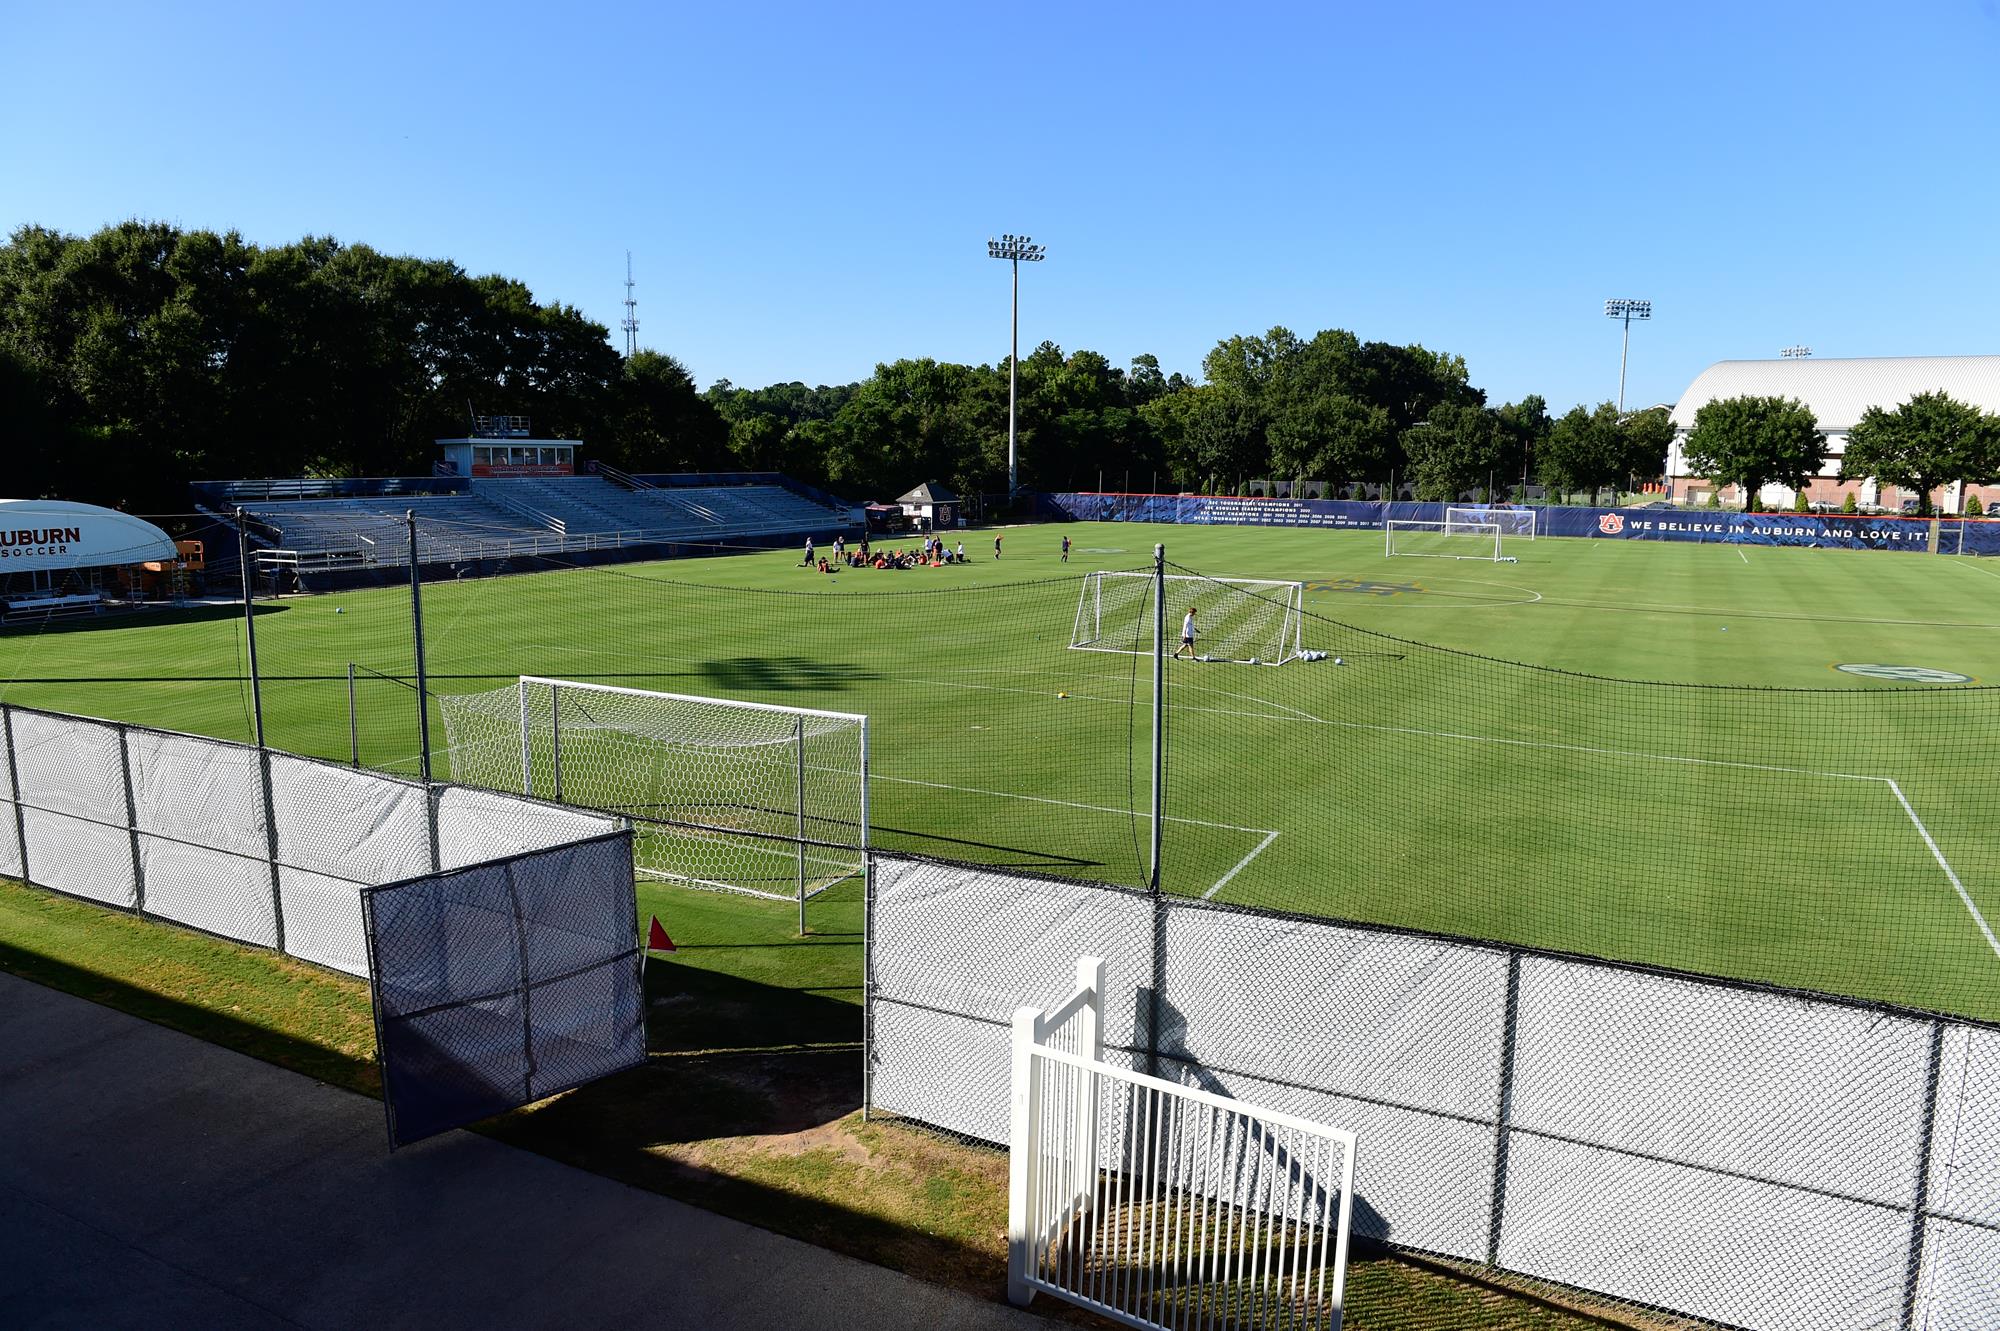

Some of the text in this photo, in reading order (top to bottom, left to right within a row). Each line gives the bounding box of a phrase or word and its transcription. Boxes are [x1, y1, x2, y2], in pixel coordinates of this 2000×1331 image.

[0, 527, 81, 547] UBURN
[1630, 521, 1929, 541] WE BELIEVE IN AUBURN AND LOVE IT!
[1, 545, 67, 558] SOCCER
